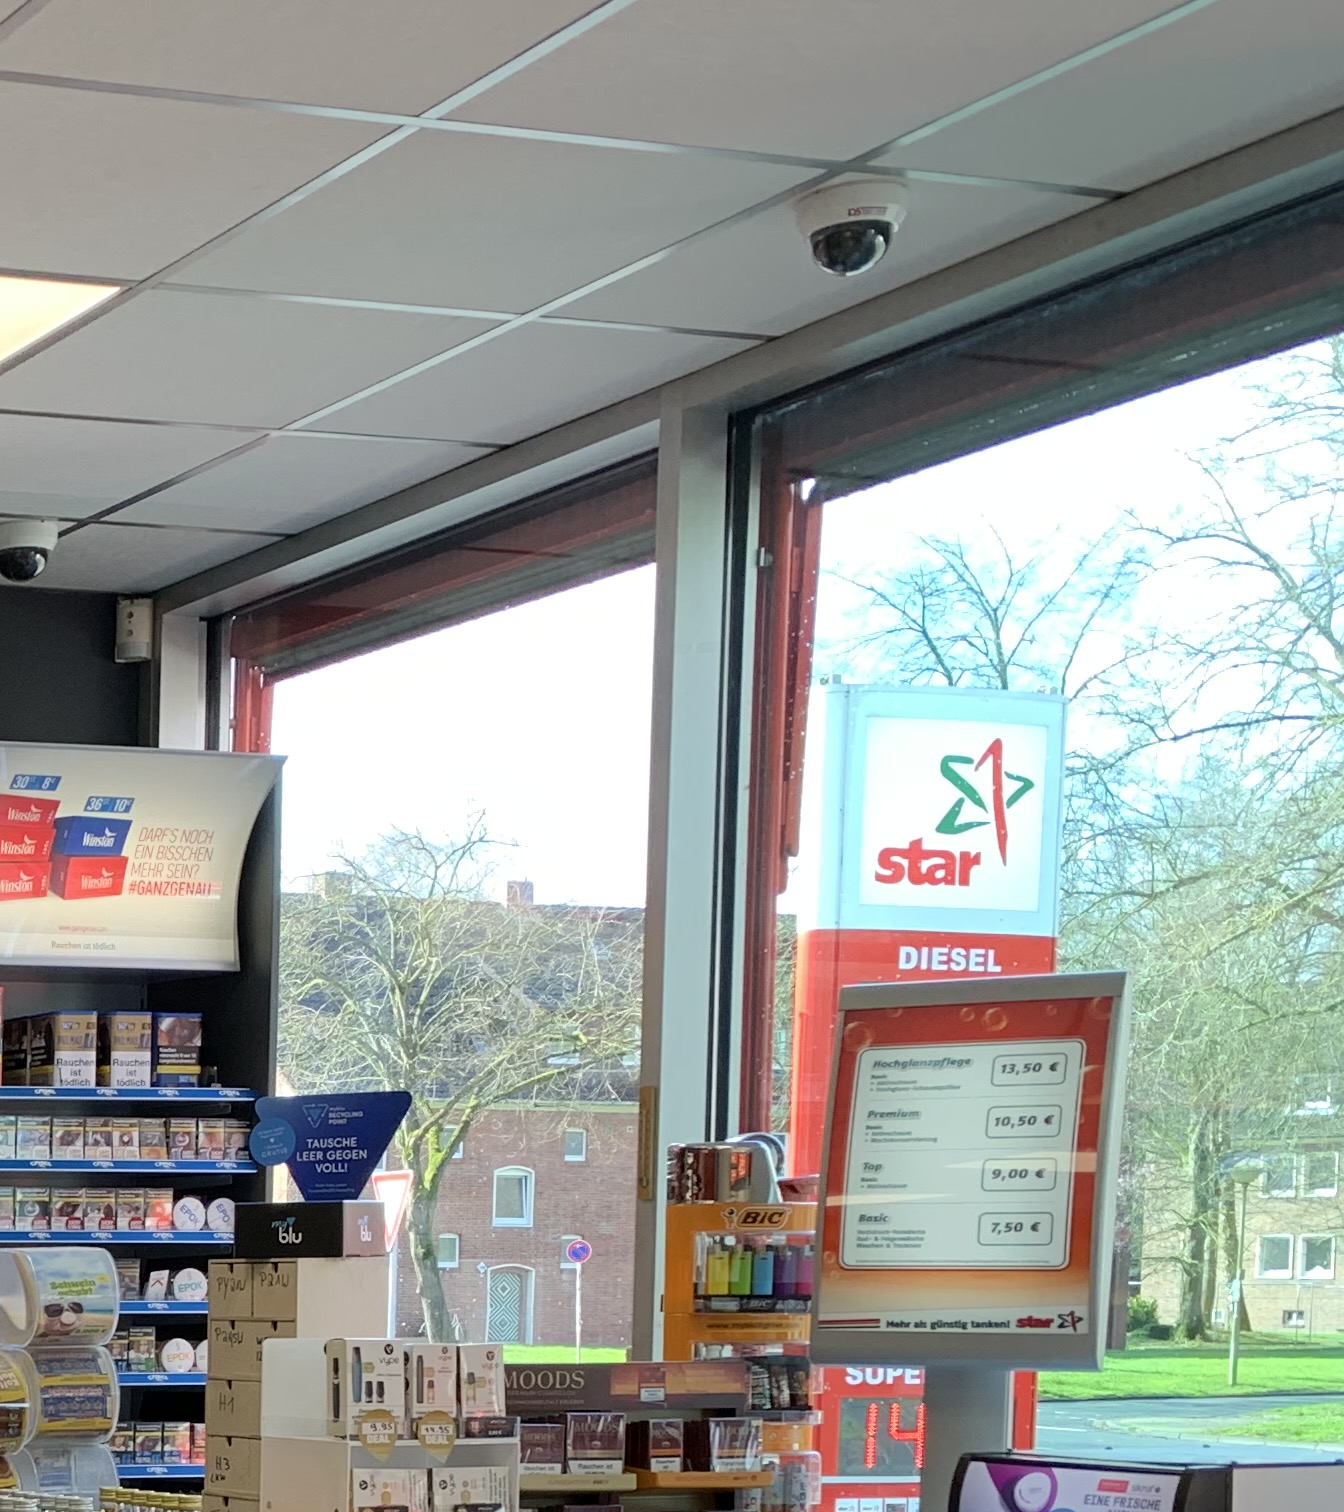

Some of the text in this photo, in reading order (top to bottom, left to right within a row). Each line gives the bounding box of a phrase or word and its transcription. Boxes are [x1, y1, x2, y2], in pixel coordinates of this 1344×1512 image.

[875, 838, 981, 886] star
[129, 880, 213, 897] #GANZGENAU
[898, 946, 1002, 972] DIESEL
[873, 1058, 1042, 1075] Hochglanzpflege 13,50
[867, 1110, 1037, 1128] Premium 10,50
[306, 1137, 357, 1148] TAUSCHE
[297, 1150, 367, 1161] LEER GEGEN
[315, 1163, 348, 1173] VOLL!
[863, 1162, 1028, 1181] Top 9,00
[859, 1214, 1023, 1235] Basic 7,50
[278, 1223, 302, 1245] blu
[886, 1320, 910, 1328] Mehr
[930, 1320, 968, 1330] günstig
[971, 1320, 1010, 1329] tanken!
[1016, 1316, 1054, 1328] star
[1084, 1494, 1161, 1511] EINE FRISCHE
